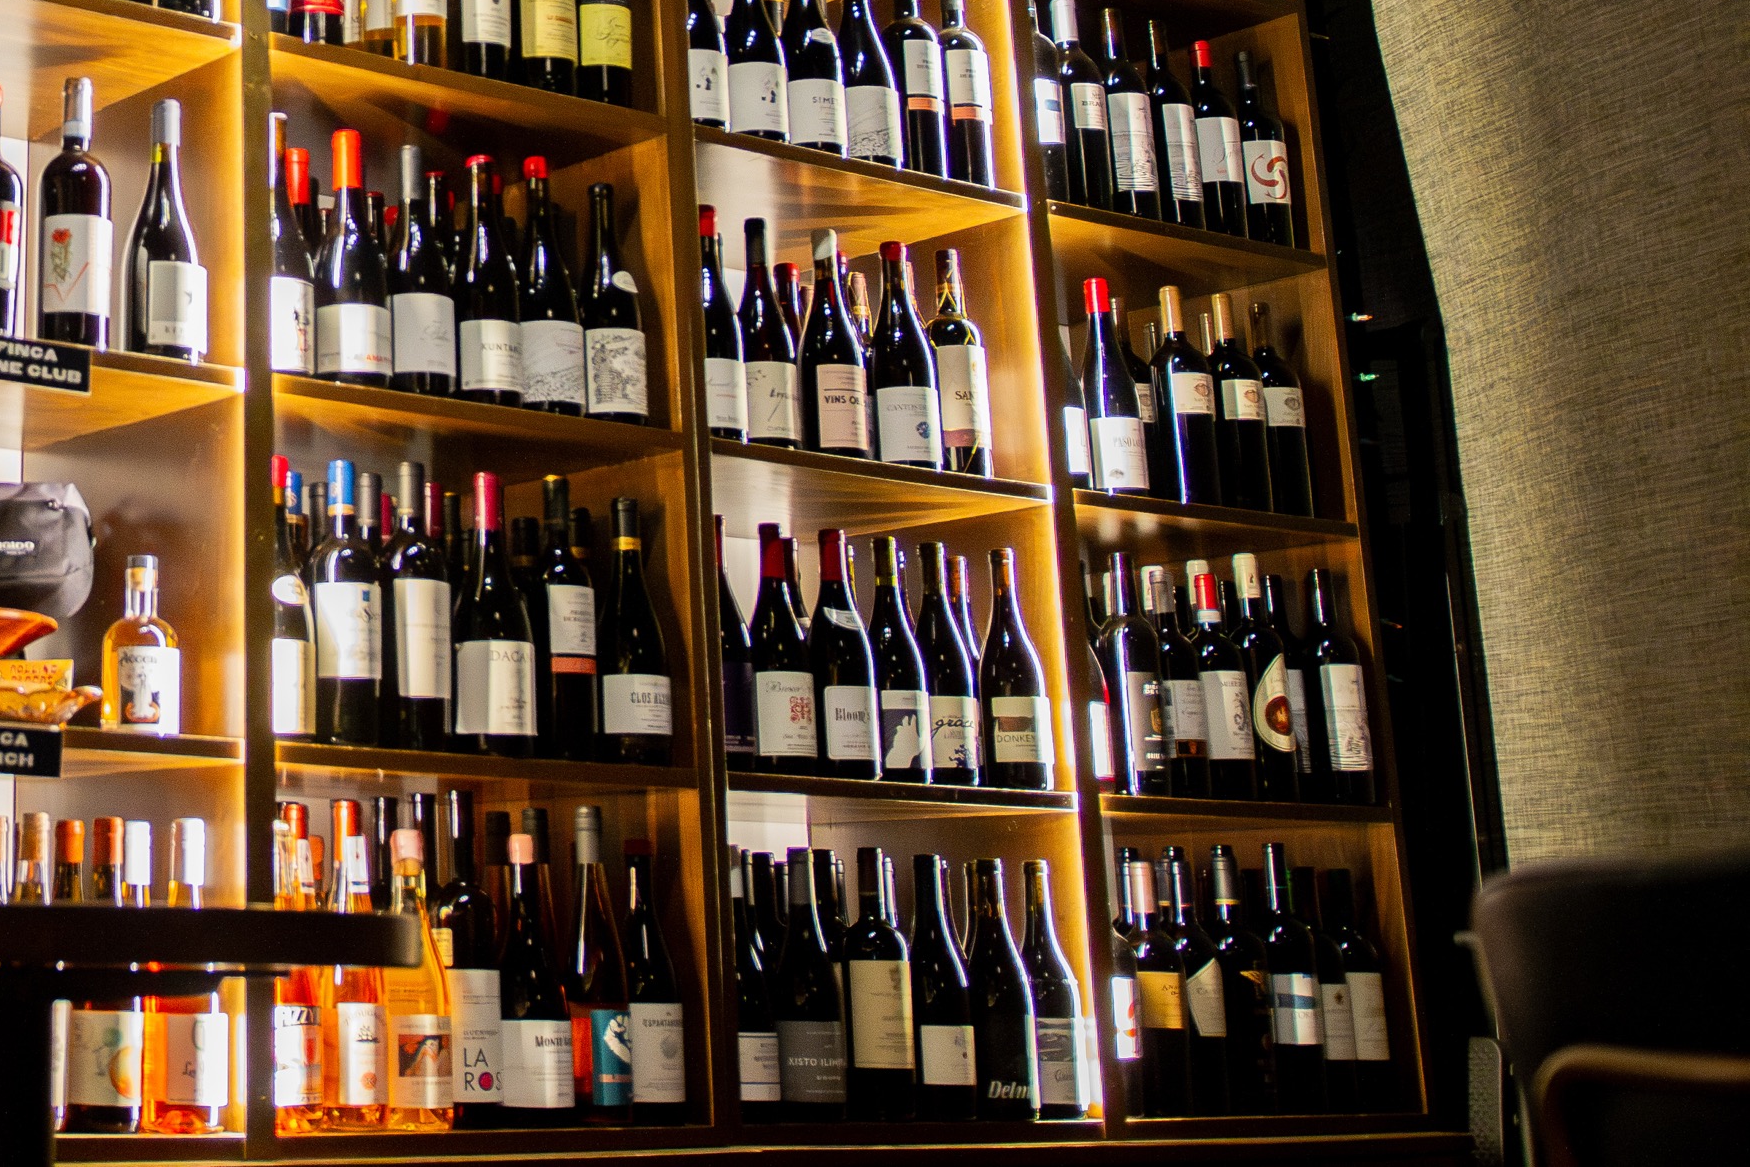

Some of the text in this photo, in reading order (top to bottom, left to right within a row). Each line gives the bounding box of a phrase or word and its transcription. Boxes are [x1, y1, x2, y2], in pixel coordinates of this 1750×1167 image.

[26, 363, 84, 386] CLUB
[823, 394, 848, 405] VINS
[463, 1047, 490, 1068] LA
